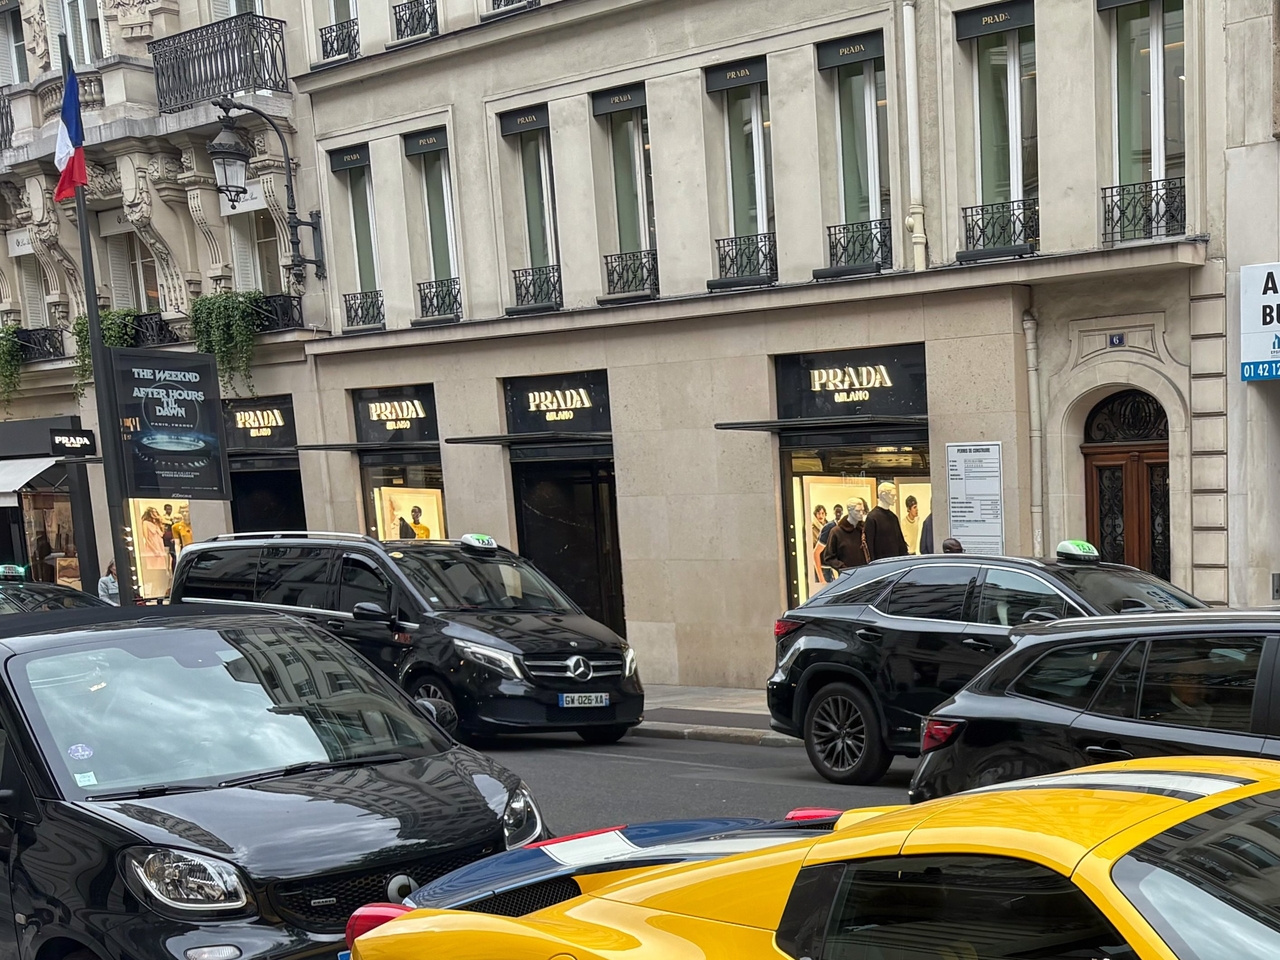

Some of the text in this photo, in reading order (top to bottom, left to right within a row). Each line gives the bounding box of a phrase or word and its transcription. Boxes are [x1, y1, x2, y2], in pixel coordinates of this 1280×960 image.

[982, 12, 1011, 26] PRADA
[839, 44, 865, 56] PRADA
[726, 68, 750, 80] PRADA
[1262, 271, 1279, 296] A
[1113, 335, 1119, 345] 6
[131, 368, 200, 382] THE WEEKND
[1244, 365, 1254, 377] 01
[1257, 363, 1269, 376] 42
[809, 364, 893, 391] PRADA
[132, 387, 204, 404] AFTER HOURS
[528, 388, 593, 411] PRADA
[834, 390, 870, 402] MILANO
[155, 405, 186, 418] DAWN
[368, 400, 426, 421] PRADA
[235, 409, 285, 428] PRADA
[54, 436, 90, 445] PRADA
